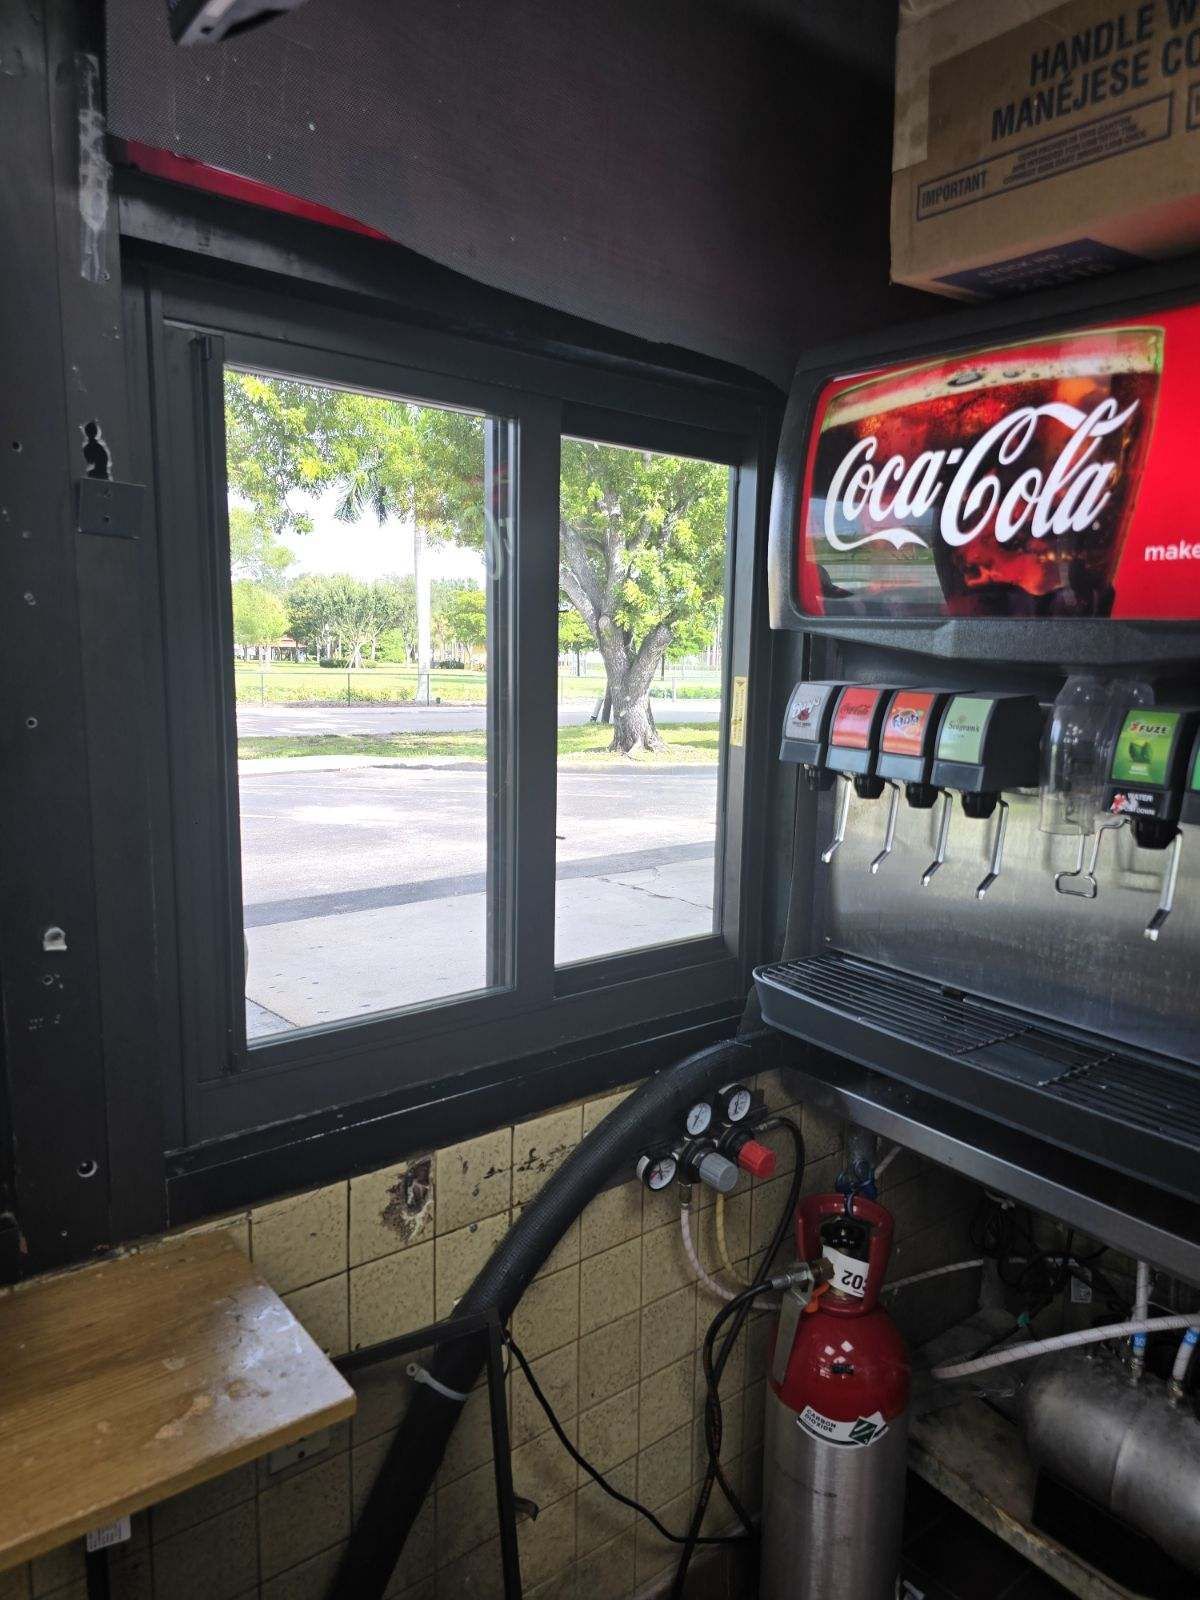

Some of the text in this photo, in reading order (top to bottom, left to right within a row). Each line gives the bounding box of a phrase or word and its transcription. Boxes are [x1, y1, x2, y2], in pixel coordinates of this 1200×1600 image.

[1029, 4, 1155, 87] HANDLE
[921, 170, 988, 209] IMPORTANT
[824, 398, 1140, 551] Coca-Cola
[1144, 540, 1200, 562] make
[1138, 725, 1169, 735] FUZE
[804, 1413, 834, 1433] DIOXIDE
[806, 1409, 837, 1428] CARBON
